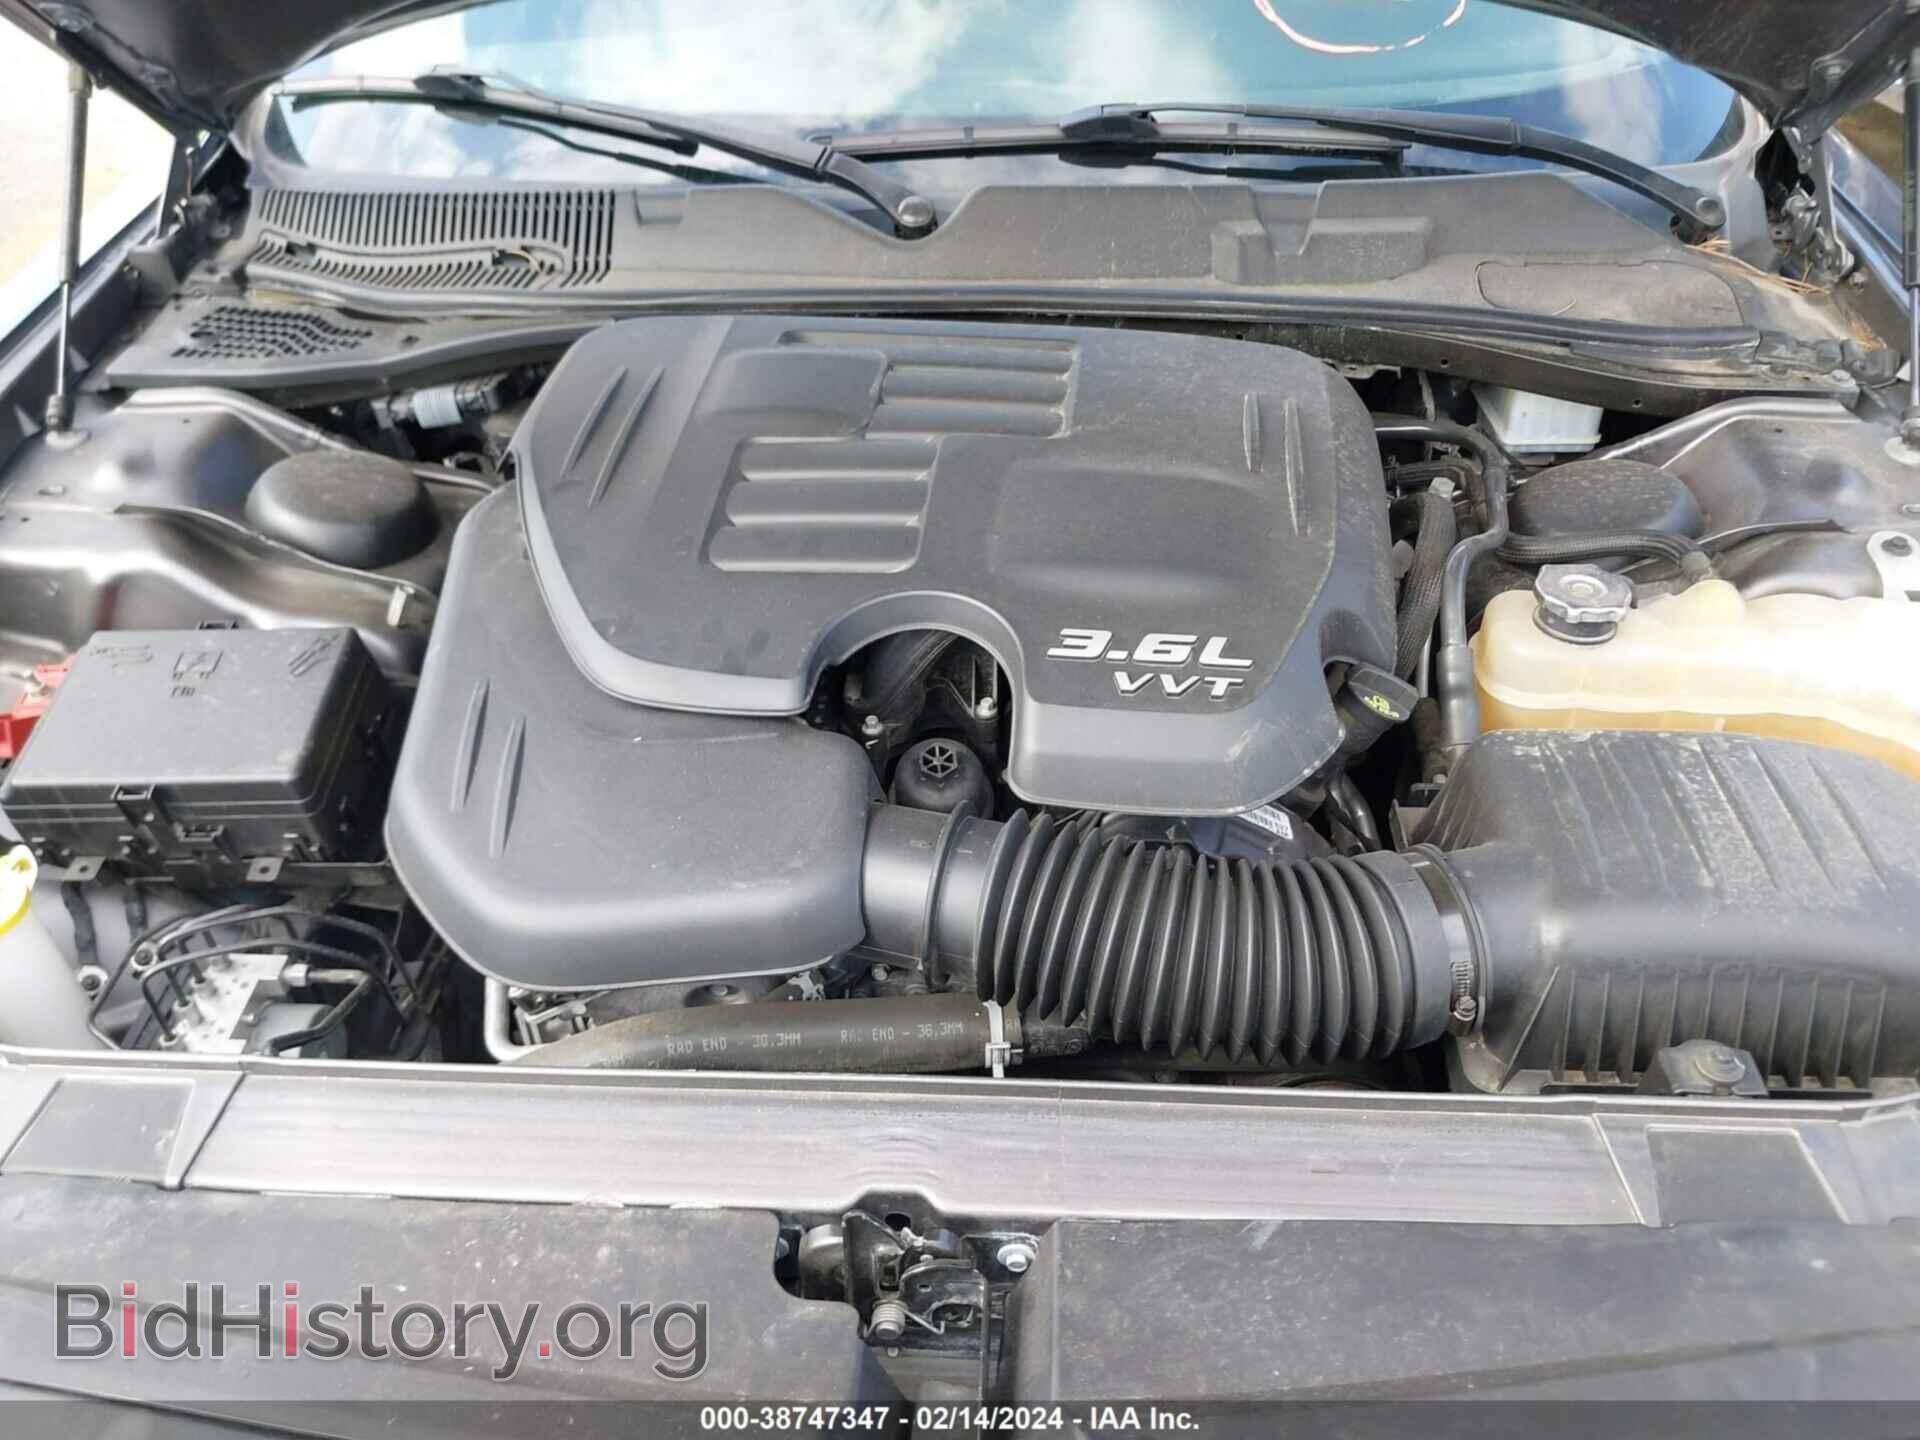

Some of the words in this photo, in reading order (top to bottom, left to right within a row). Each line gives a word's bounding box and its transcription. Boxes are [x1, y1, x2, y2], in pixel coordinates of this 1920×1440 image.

[1047, 628, 1253, 668] 3.6L
[1113, 671, 1244, 698] VVT
[702, 1036, 727, 1052] END
